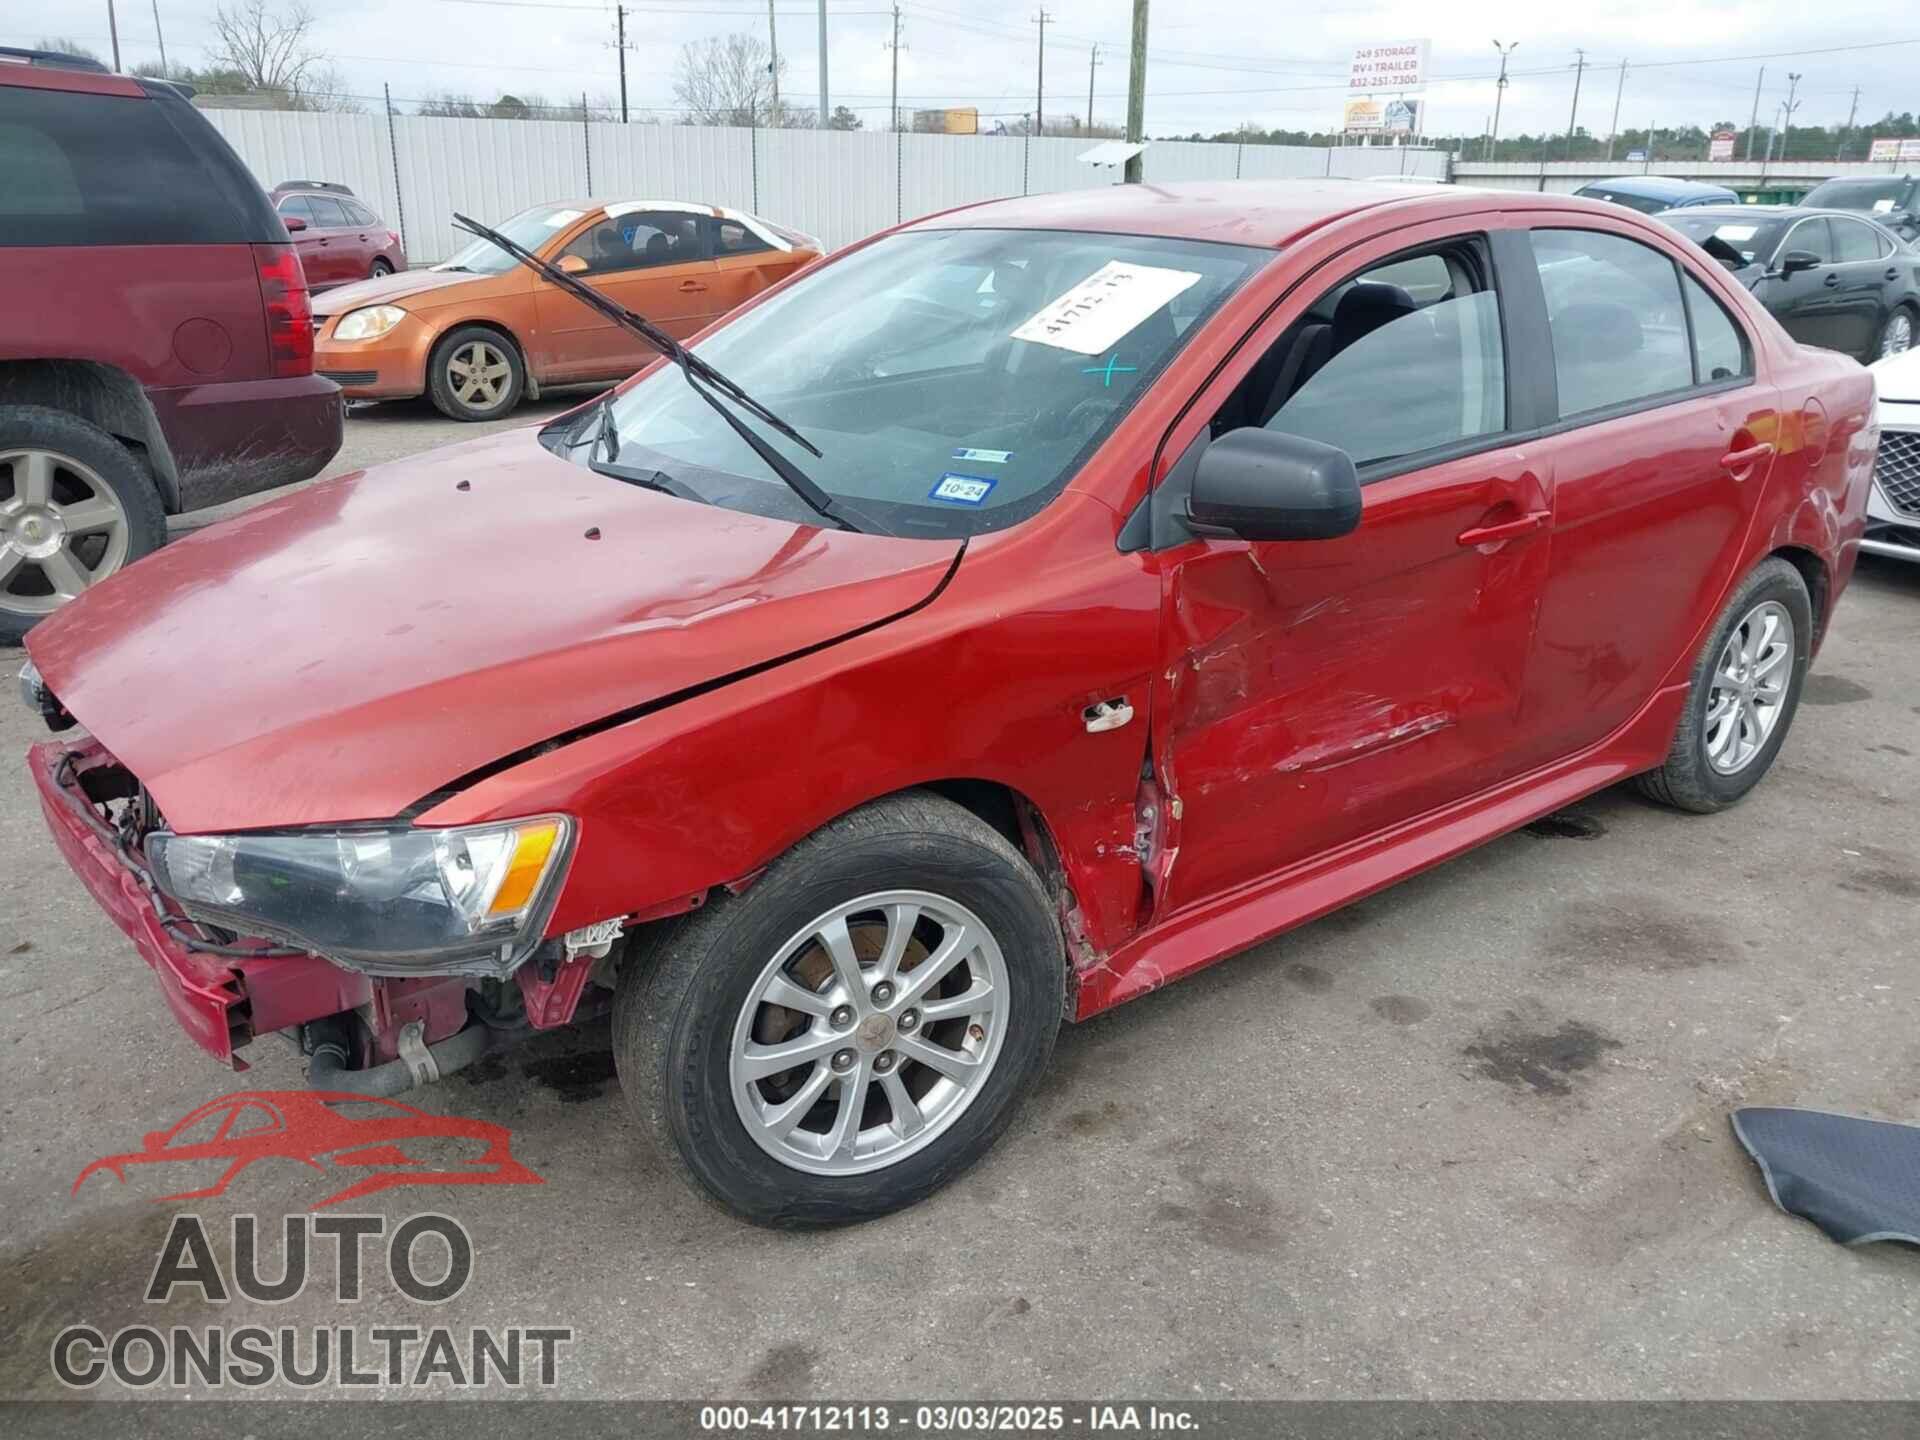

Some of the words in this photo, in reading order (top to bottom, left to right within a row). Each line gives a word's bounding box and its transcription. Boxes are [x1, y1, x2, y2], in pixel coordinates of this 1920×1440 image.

[1355, 50, 1372, 59] 249
[1374, 47, 1416, 57] STORAGE
[1375, 61, 1416, 72] TRAILER
